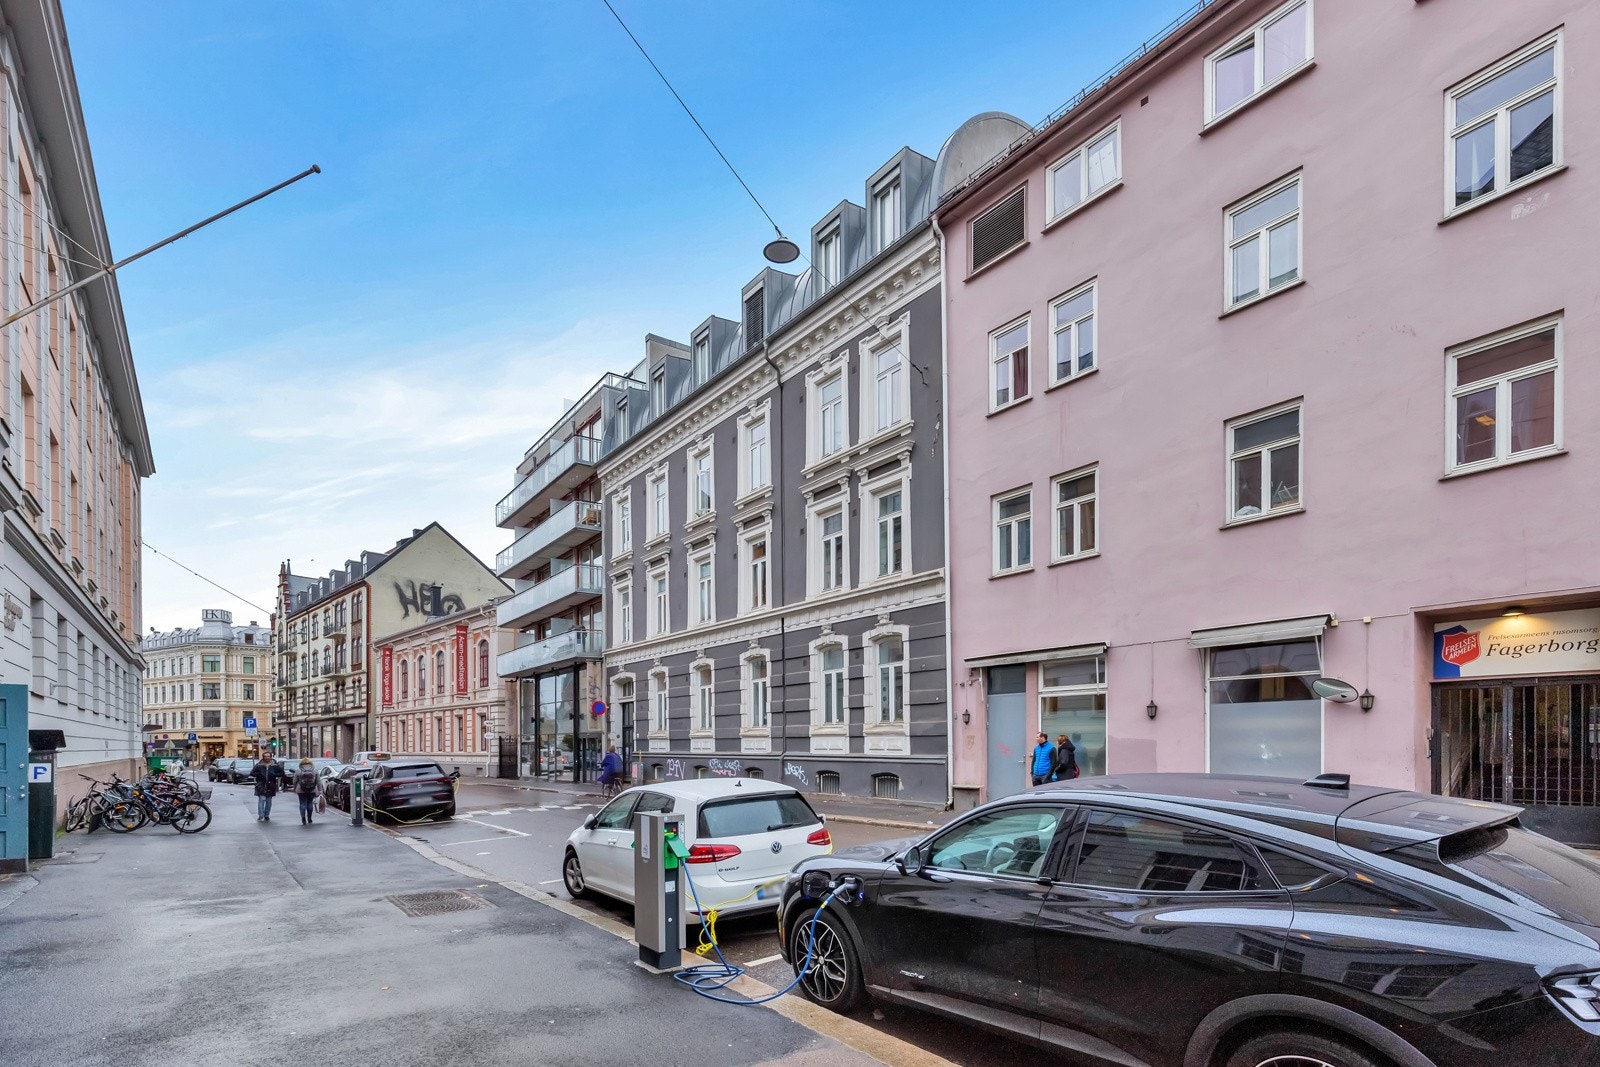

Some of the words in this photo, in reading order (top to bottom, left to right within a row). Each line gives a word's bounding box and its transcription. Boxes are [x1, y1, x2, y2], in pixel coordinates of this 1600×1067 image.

[1488, 631, 1550, 641] Frelsesarmeens
[1448, 642, 1477, 661] ARMEEN
[1486, 638, 1600, 659] Fagerborg
[247, 719, 254, 727] P
[33, 766, 48, 780] P
